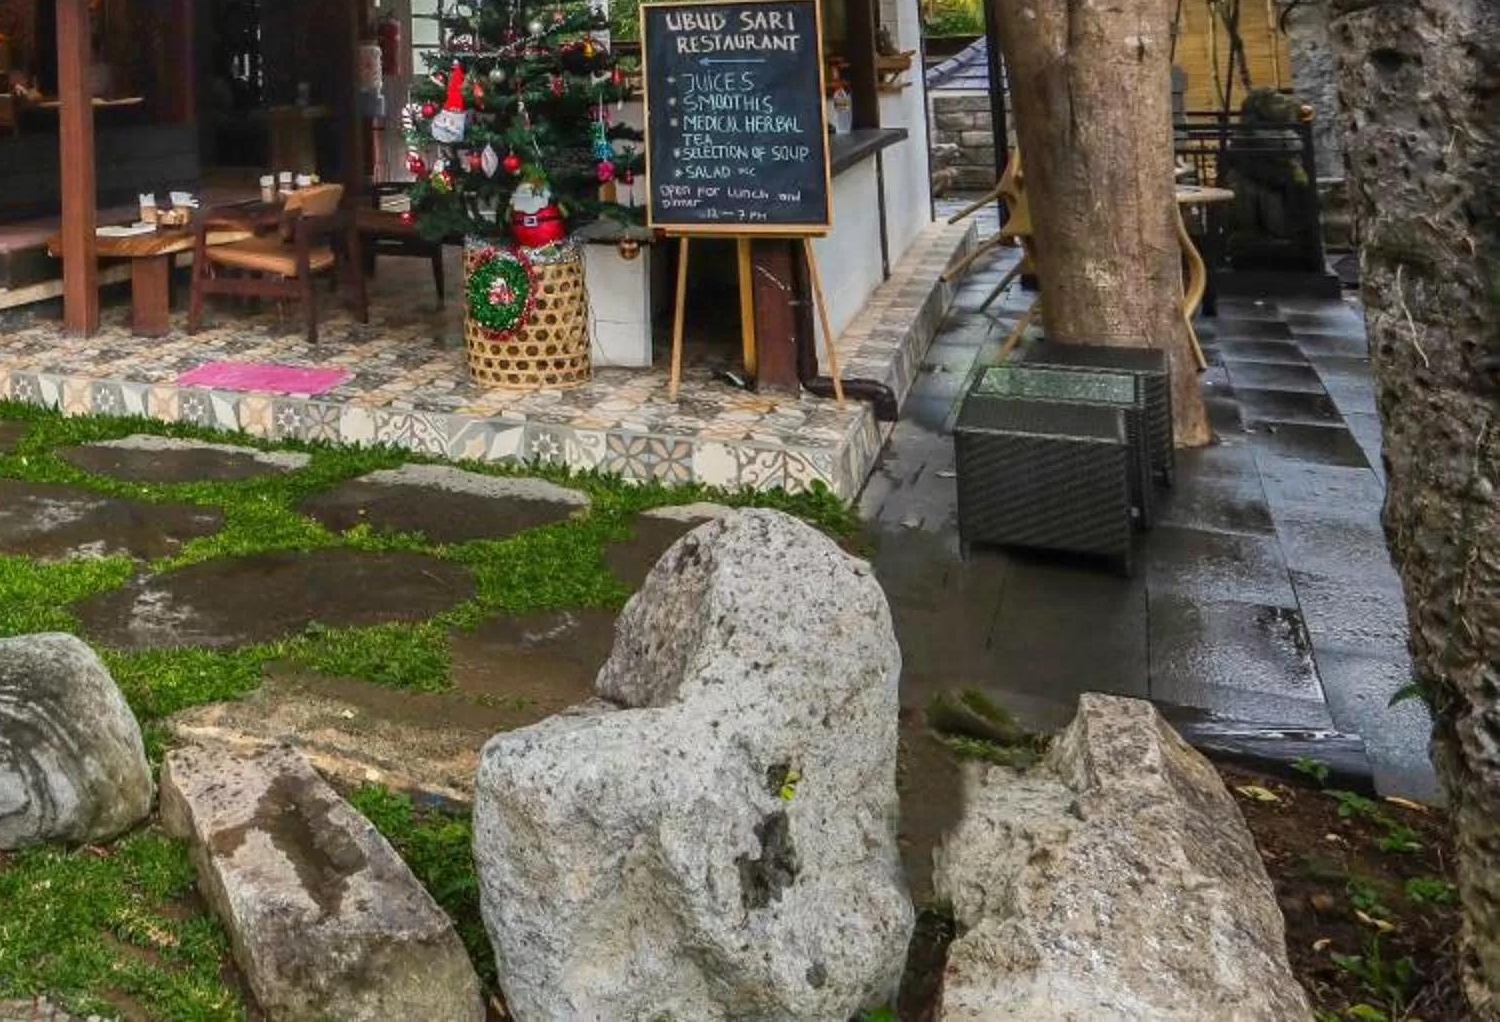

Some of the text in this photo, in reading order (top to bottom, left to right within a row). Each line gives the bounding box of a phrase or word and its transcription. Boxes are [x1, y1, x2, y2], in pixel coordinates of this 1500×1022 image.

[665, 11, 795, 31] UBUD SARI
[677, 34, 800, 54] RESTAURANT
[745, 115, 804, 133] HERBAL
[682, 133, 712, 146] TEA
[751, 146, 767, 162] OF
[772, 146, 810, 162] SOUP
[685, 165, 731, 178] SALAD
